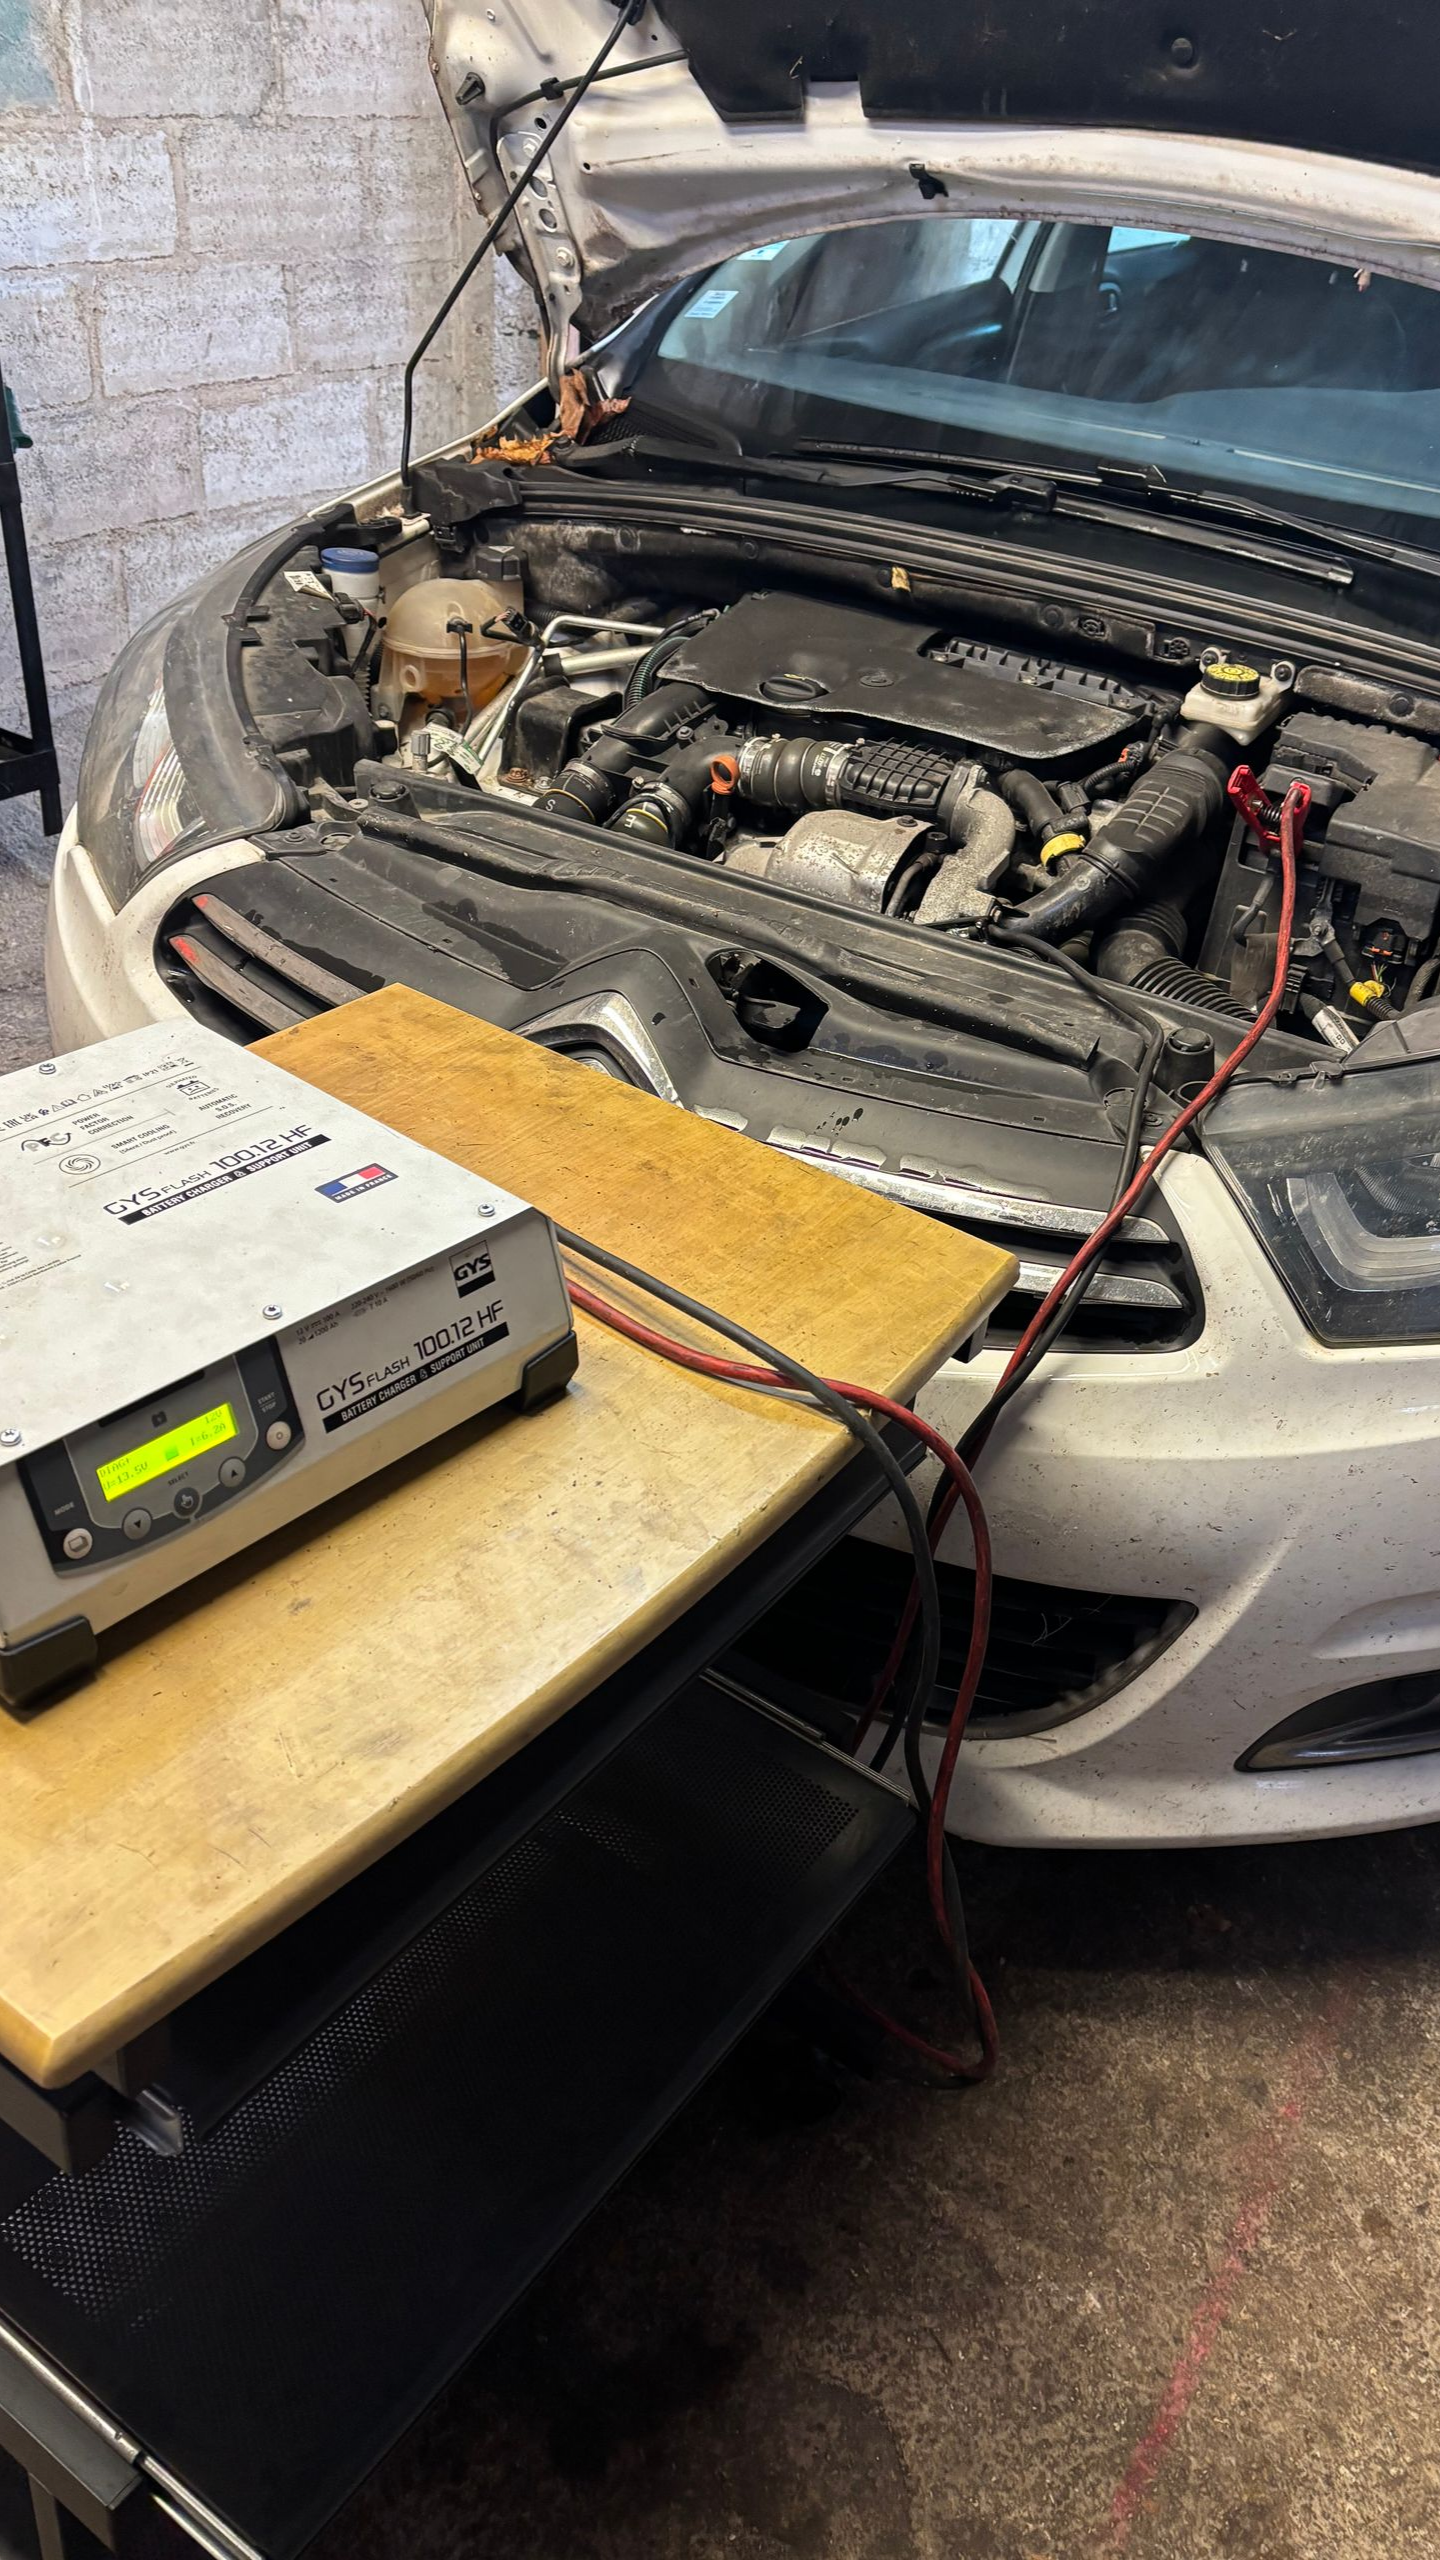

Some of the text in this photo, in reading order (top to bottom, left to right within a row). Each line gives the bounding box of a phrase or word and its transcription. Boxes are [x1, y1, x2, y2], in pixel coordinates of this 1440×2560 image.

[198, 1093, 238, 1111] AUTOMATIC
[215, 1103, 252, 1120] RECOVERY
[71, 1112, 101, 1126] POWER
[79, 1116, 111, 1131] FACTOR
[87, 1115, 135, 1135] CORRECTION
[110, 1124, 171, 1149] SMART COOLING
[208, 1138, 284, 1170] 100.12
[279, 1124, 313, 1143] HF
[141, 1141, 313, 1217] BATTERY CHARGER & SUPPORT UNIT
[334, 1189, 356, 1200] MADE
[365, 1174, 393, 1188] FRANCE
[453, 1253, 492, 1281] GYS
[413, 1316, 475, 1360] 100.12
[477, 1299, 505, 1329] HF
[340, 1337, 487, 1422] BATTERY CHARGER & SUPPORT UNIT
[261, 1401, 277, 1413] STOP
[167, 1470, 190, 1487] SELECT
[54, 1501, 75, 1516] MODE
